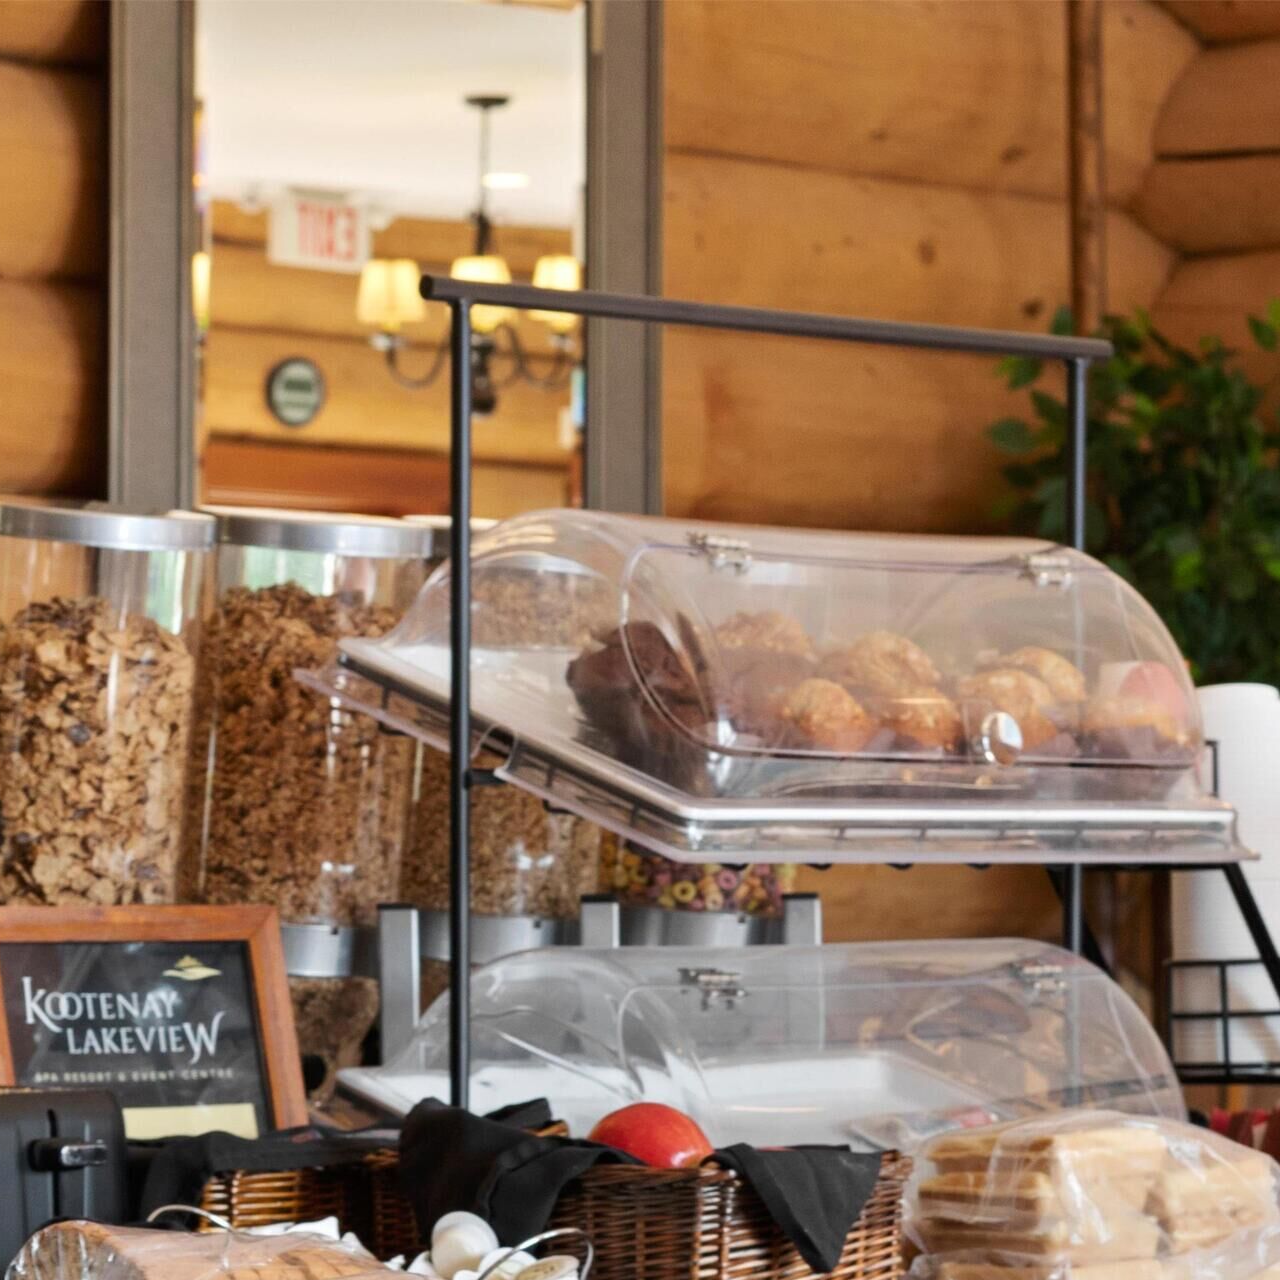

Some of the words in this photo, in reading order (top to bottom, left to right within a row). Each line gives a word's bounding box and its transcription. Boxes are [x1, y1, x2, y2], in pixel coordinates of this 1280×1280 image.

[22, 976, 180, 1032] KOOTENAY
[66, 1010, 227, 1065] LAKEVIEW
[63, 1071, 112, 1083] RESORT
